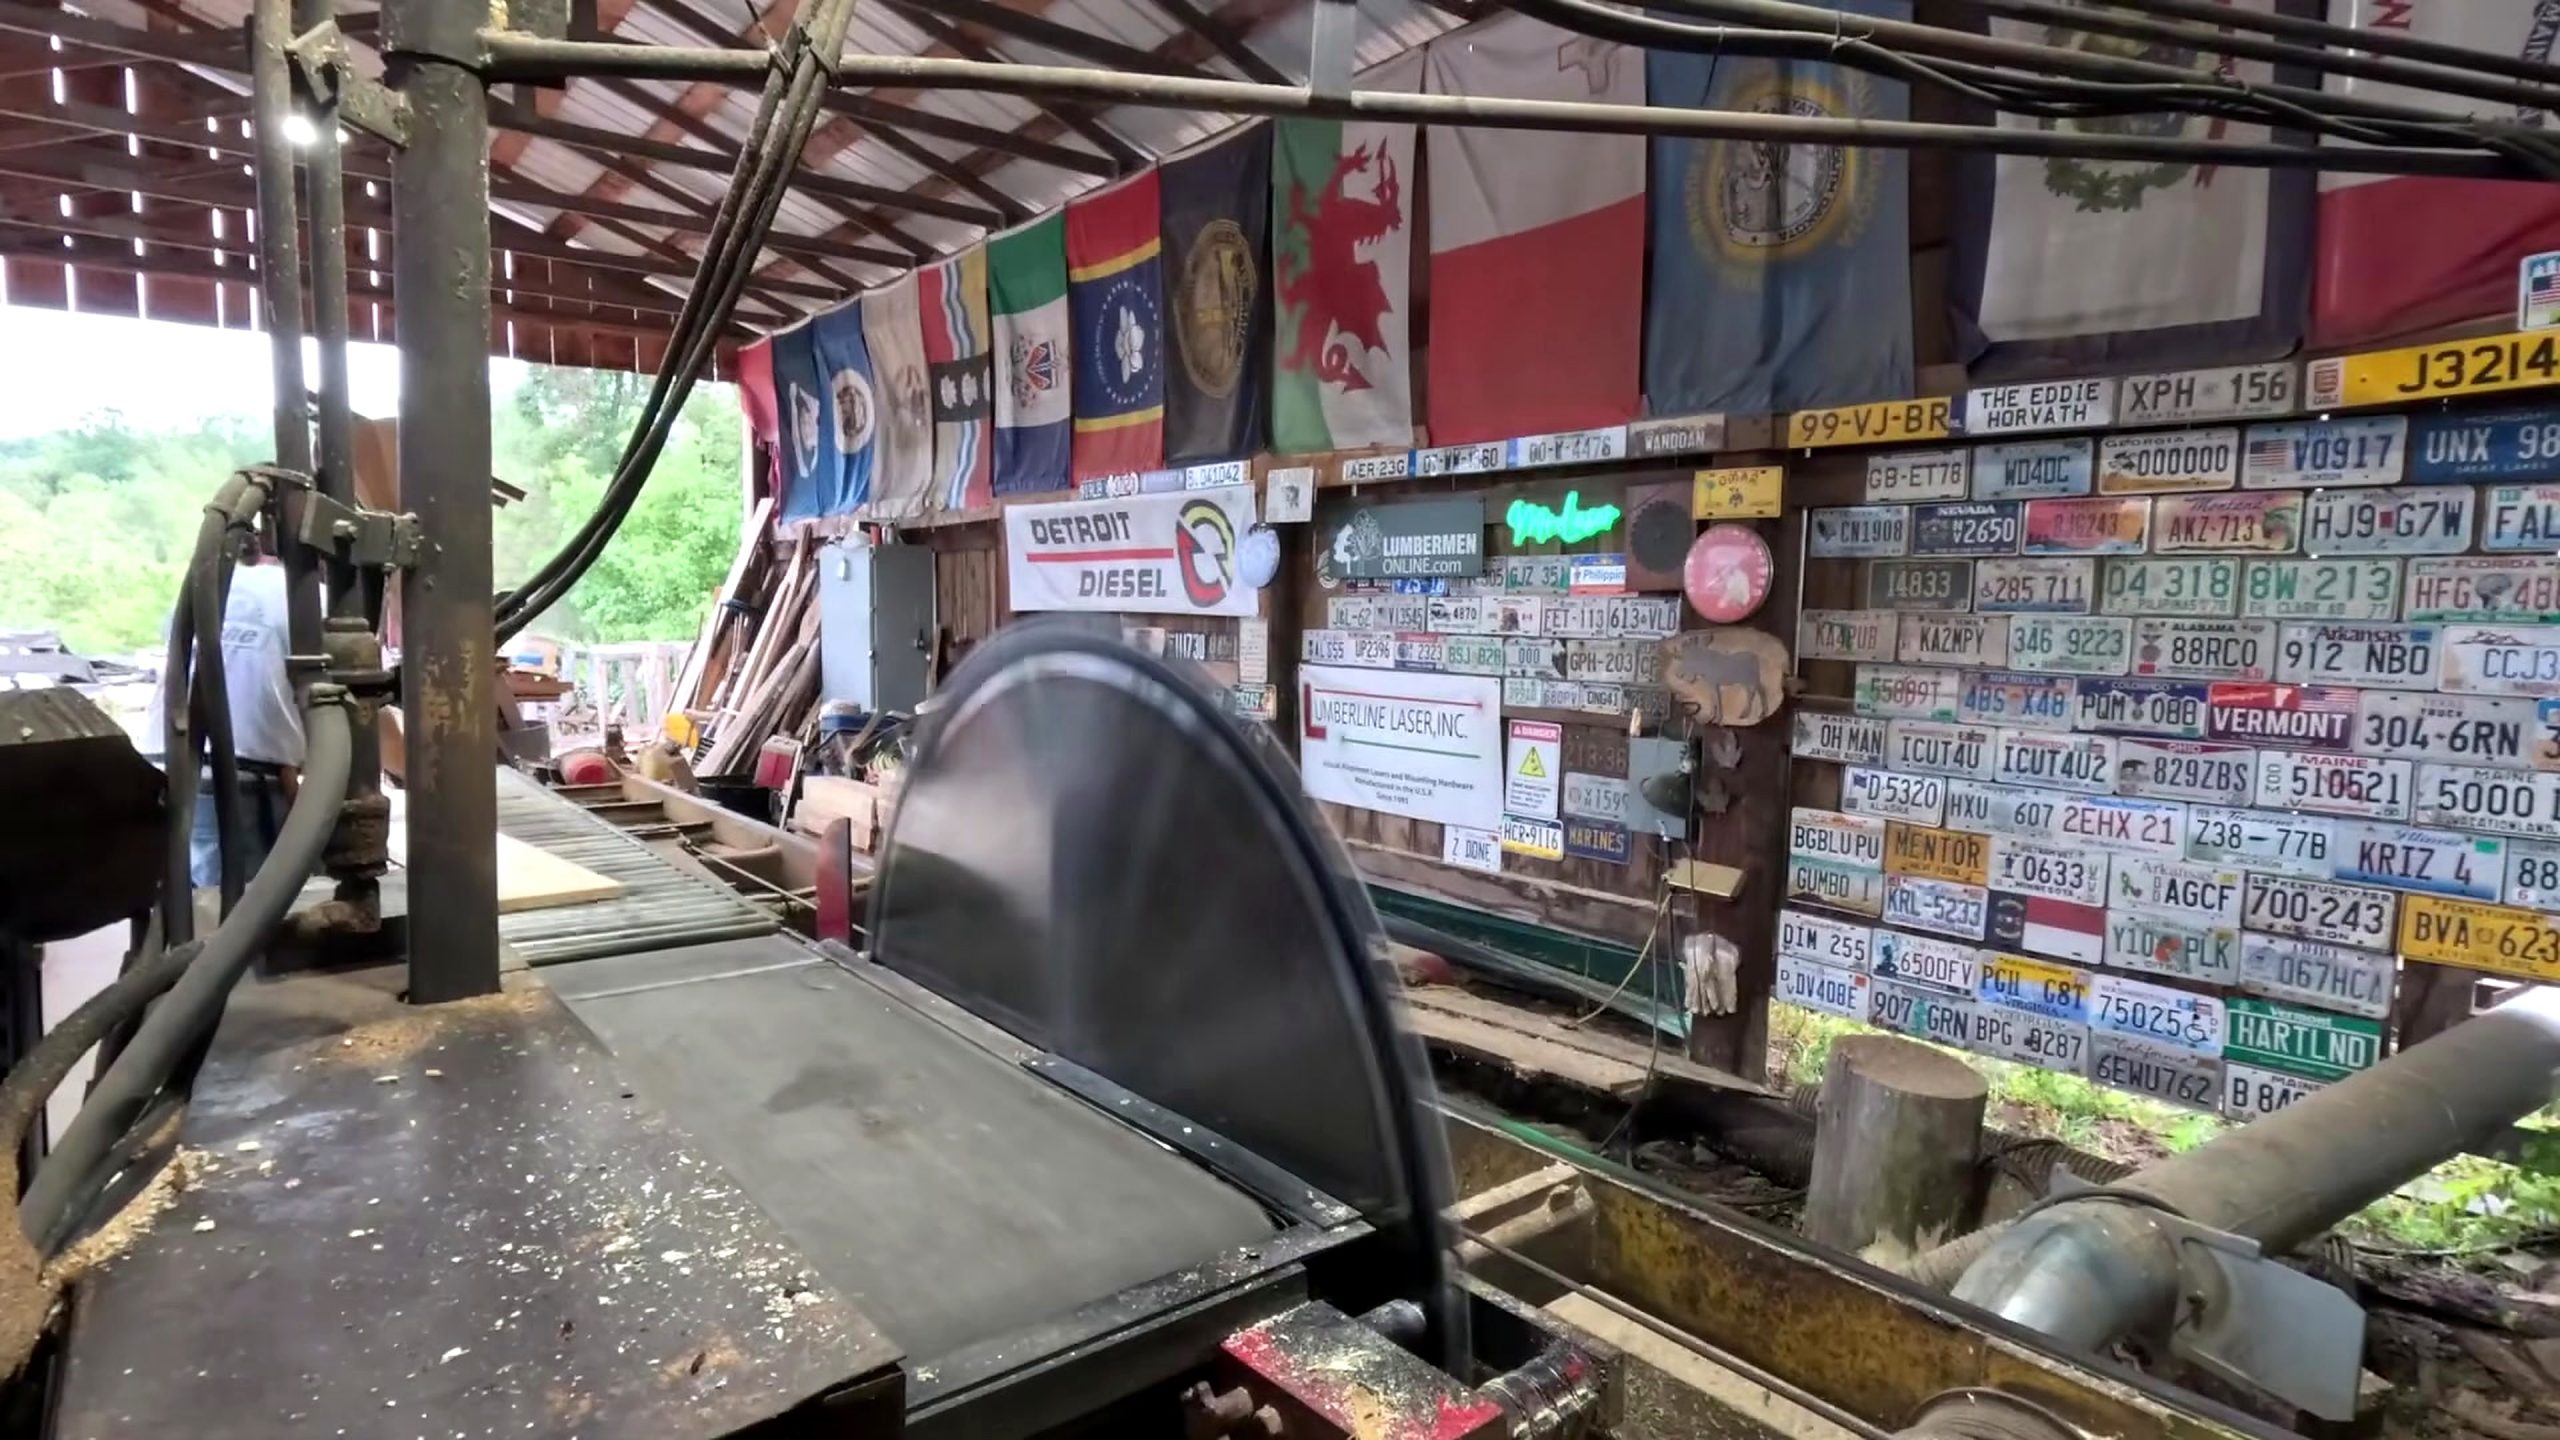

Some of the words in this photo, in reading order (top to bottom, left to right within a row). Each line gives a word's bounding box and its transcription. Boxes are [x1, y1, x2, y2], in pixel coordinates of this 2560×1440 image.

[1981, 391, 2025, 410] THE
[2030, 382, 2100, 406] EDDIE
[2129, 377, 2196, 413] XPH
[2230, 371, 2288, 405] 156
[1801, 401, 1948, 442] 99-VJ-BR
[1987, 404, 2088, 429] HORVATH
[2104, 436, 2185, 449] GEORGIA
[2426, 426, 2492, 464] UNX
[1937, 504, 1996, 516] NEVADA
[2311, 503, 2376, 540] HJ9
[2395, 500, 2464, 537] G7W
[1031, 511, 1130, 545] DETROIT
[1962, 518, 2016, 544] 2650
[1382, 533, 1477, 557] LUMBERMEN
[1382, 557, 1462, 575] ONLINE.com
[2164, 564, 2232, 599] 318
[1078, 568, 1167, 598] DIESEL
[1994, 576, 2034, 603] 285
[2045, 574, 2084, 602] 711
[2249, 566, 2298, 600] 8W
[2314, 566, 2392, 600] 213
[2415, 576, 2471, 610] HFG
[2067, 627, 2124, 657] 9223
[2172, 622, 2236, 634] ALABAMA
[2314, 625, 2404, 643] Arkansas
[1569, 652, 1633, 673] GPH-203
[2285, 640, 2344, 672] 912
[1521, 726, 1557, 739] DANGER
[2213, 706, 2348, 740] VERMONT
[2364, 714, 2521, 757] 304-6RN
[1820, 724, 1842, 749] OH
[1849, 724, 1883, 755] MAN
[1901, 736, 1981, 770] ICUT4U
[2167, 743, 2202, 754] OHIO
[2300, 754, 2369, 769] MAINE
[2474, 770, 2537, 784] MAINE
[1949, 793, 1989, 821] HXU
[2013, 801, 2055, 829] 607
[1569, 825, 1625, 853] MARINES
[1894, 827, 1981, 870] MENTOR
[1796, 867, 1850, 899] GUMBO
[2453, 852, 2473, 887] 4
[2164, 877, 2236, 912] AGCF
[2279, 879, 2361, 898] KENTUCKY
[2250, 884, 2385, 936] 700-243
[1783, 923, 1818, 951] DIM
[1829, 934, 1866, 962] 255
[2283, 924, 2350, 942] NELSON
[2414, 911, 2470, 950] BVA
[1874, 992, 1914, 1025] 907
[1927, 1004, 1969, 1041] GRN
[1976, 1016, 2013, 1046] BPG
[2098, 994, 2182, 1038] 75025
[2269, 1006, 2333, 1028] Vermont
[2238, 1013, 2368, 1069] HARTLND
[2095, 1050, 2212, 1106] 6EWU762
[2233, 1072, 2250, 1108] B
